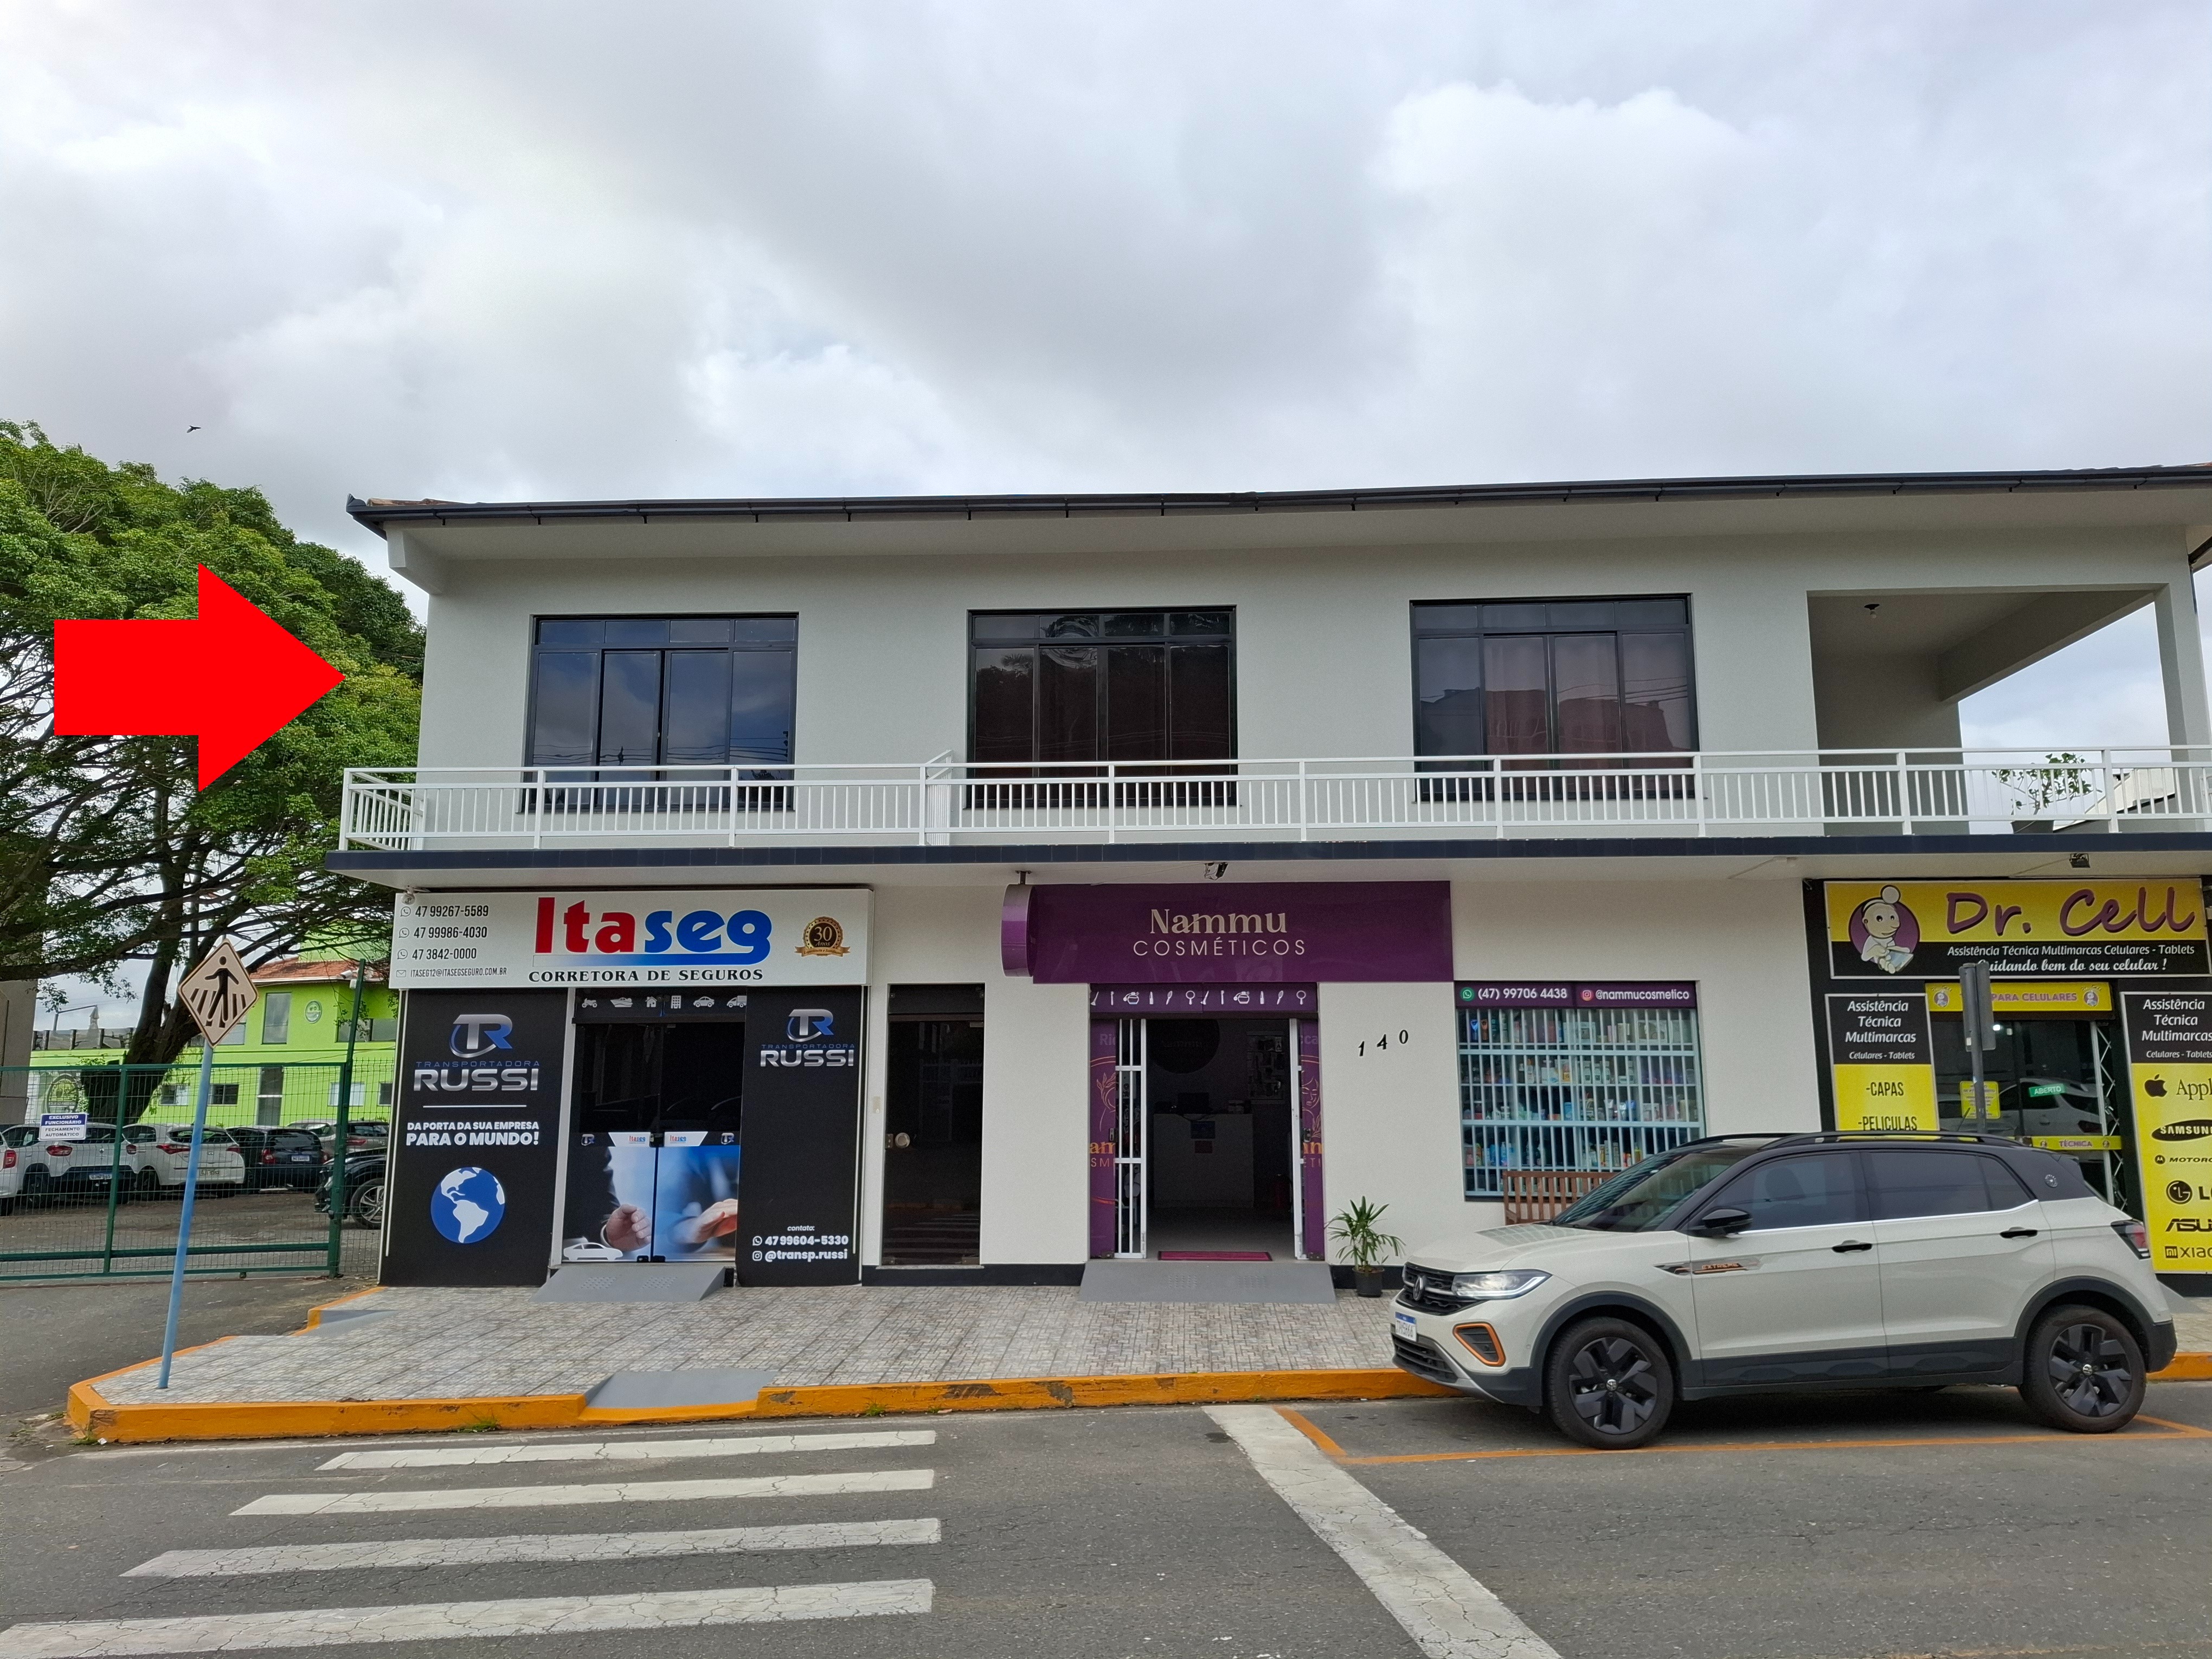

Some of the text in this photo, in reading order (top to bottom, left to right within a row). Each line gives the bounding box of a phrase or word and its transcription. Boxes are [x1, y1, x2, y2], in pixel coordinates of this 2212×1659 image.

[415, 905, 488, 917] 47 99267-5589
[1946, 886, 2196, 936] Dr. Cell
[1150, 909, 1288, 934] Nammu
[414, 927, 487, 938] 47 99986-4030
[534, 897, 772, 965] Itaseg
[814, 926, 832, 941] 30
[1133, 936, 1305, 956] COSMÉTICOS
[1947, 946, 1999, 956] Assistência
[2002, 945, 2039, 955] Técnica
[2041, 945, 2102, 955] Multimarcas
[2104, 945, 2150, 955] Celulares
[2158, 944, 2195, 954] Tablets
[412, 948, 477, 960] 47 3842-0000
[2041, 959, 2067, 972] bem
[2069, 959, 2086, 971] do
[2088, 962, 2110, 971] seu
[2113, 958, 2159, 970] celular
[410, 967, 507, 978] ITASEG12@ITASEGSEGURO.COM.BR
[529, 969, 763, 982] CORRETORA DE SEGUROS
[1478, 988, 1567, 1000] (47) 99706 4438
[1596, 989, 1689, 1001] @nammucosmetico
[1991, 992, 2078, 1002] PARA CELULARES
[1847, 1000, 1909, 1012] Assistência
[2143, 999, 2205, 1010] Assistência
[1857, 1015, 1901, 1027] Técnica
[2153, 1014, 2198, 1026] Técnica
[1845, 1031, 1917, 1043] Multimarcas
[2142, 1030, 2212, 1041] Multimarcas
[760, 1050, 854, 1067] RUSSI
[1849, 1051, 1883, 1059] Celulares
[1888, 1051, 1915, 1059] Tablets
[414, 1069, 539, 1091] RUSSI
[1866, 1082, 1904, 1096] -CAPAS
[2034, 1085, 2062, 1095] ABERTO
[407, 1121, 539, 1130] DA PORTA DA SUA EMPRESA
[2160, 1126, 2212, 1134] SAMSUN
[406, 1131, 539, 1146] PARA O MUNDO!
[2059, 1139, 2092, 1147] TÉCNICA
[2198, 1186, 2212, 1200] L
[765, 1235, 849, 1245] 47 99604-5330
[765, 1248, 848, 1262] @transp.russi
